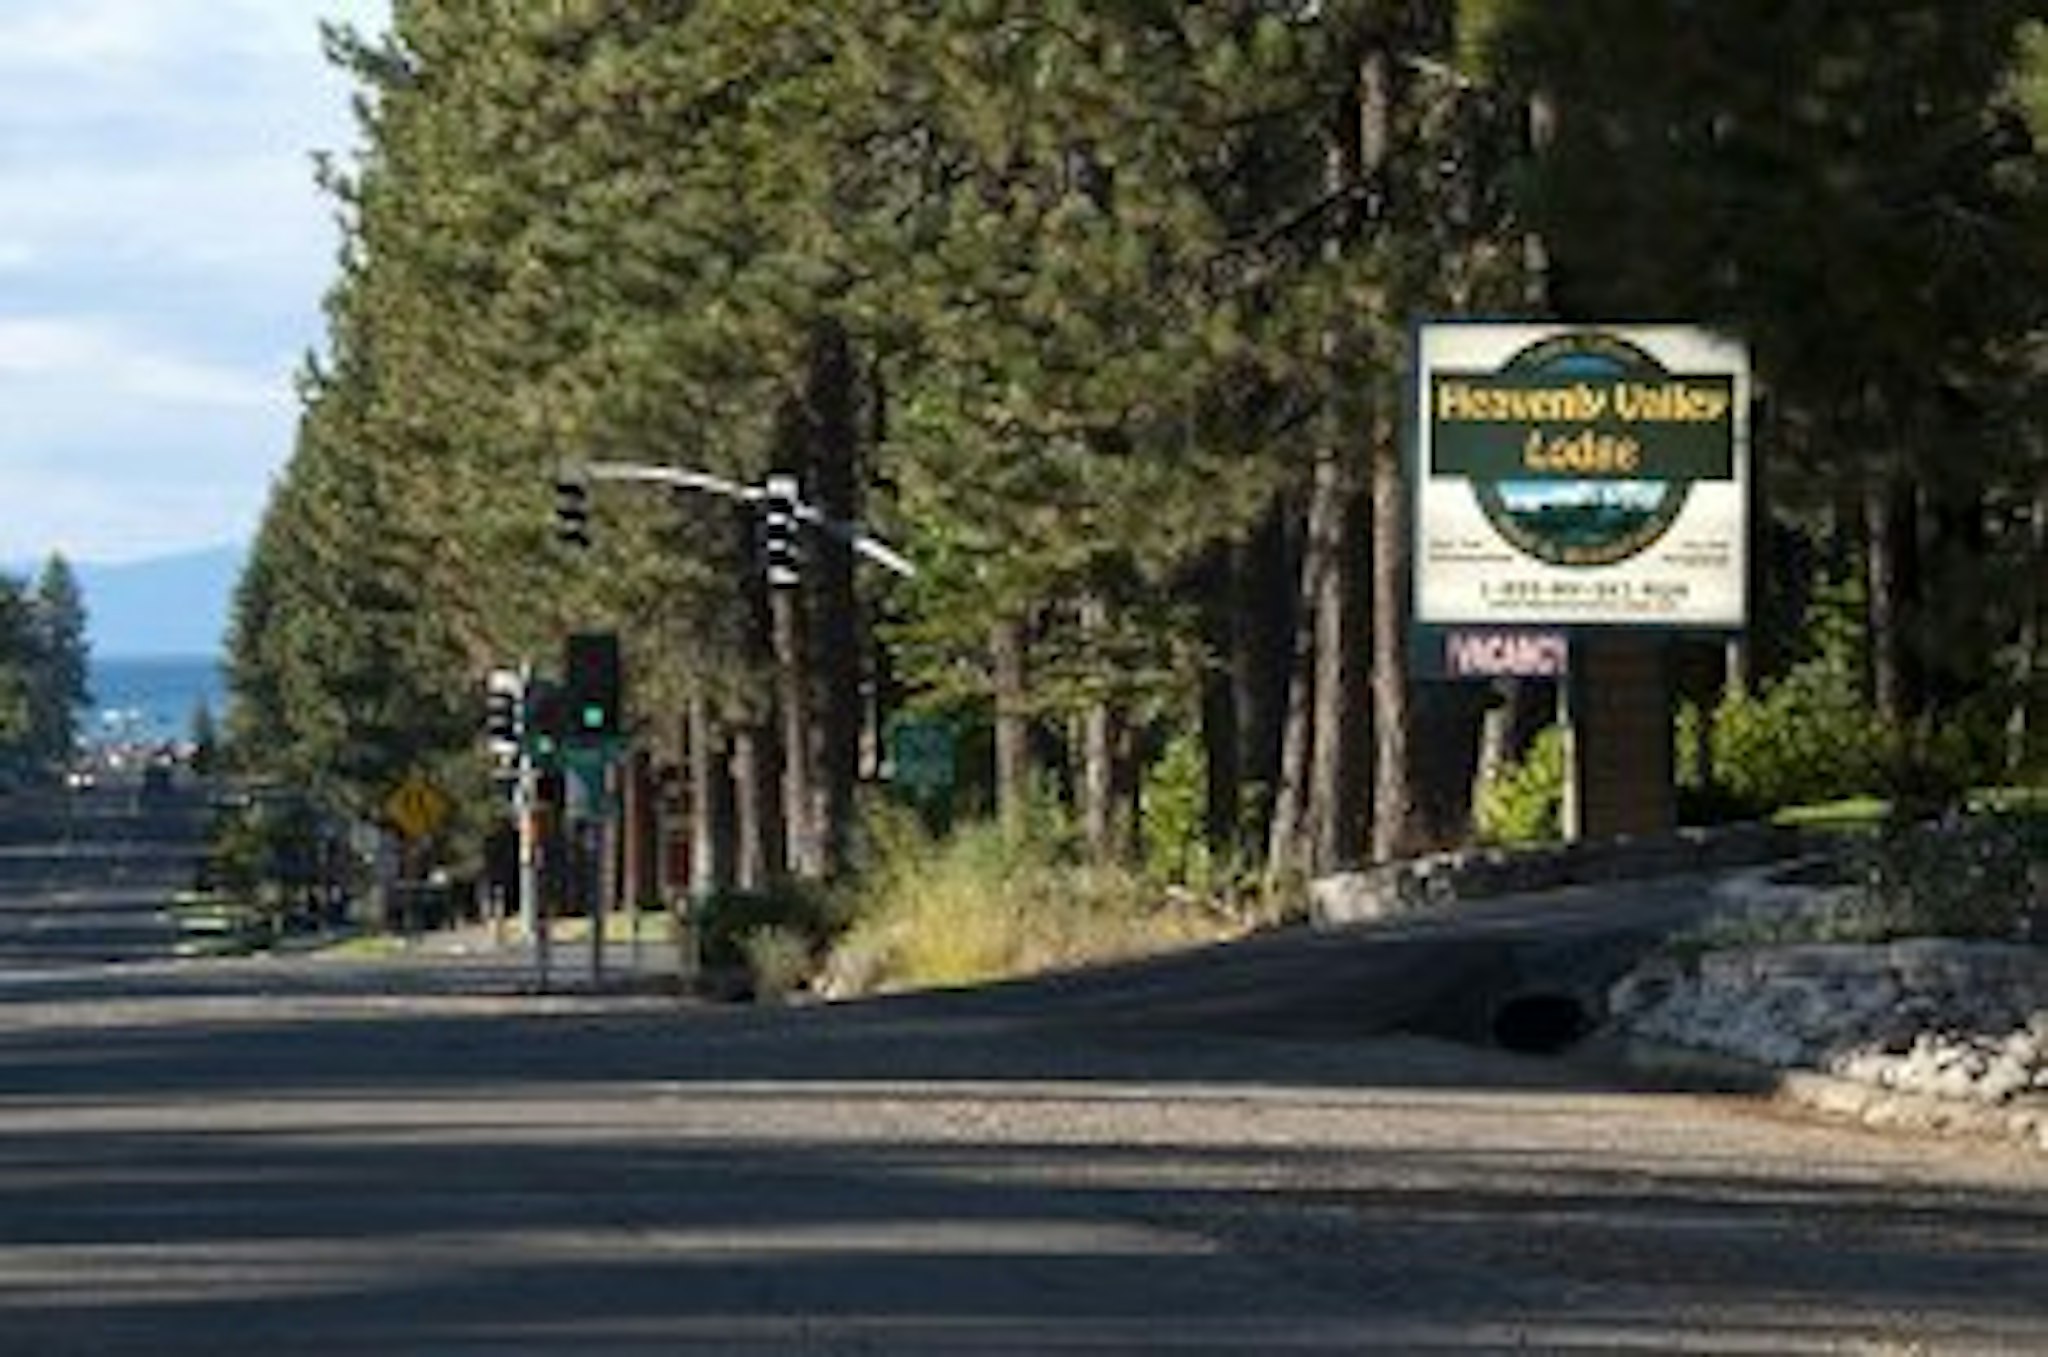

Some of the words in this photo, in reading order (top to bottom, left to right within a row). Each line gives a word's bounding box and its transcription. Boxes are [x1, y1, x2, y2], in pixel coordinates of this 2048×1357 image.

[1438, 383, 1606, 421] Heavenly
[1614, 383, 1730, 422] Valley
[1524, 429, 1640, 472] Lodge
[1450, 633, 1568, 677] VACANCY
